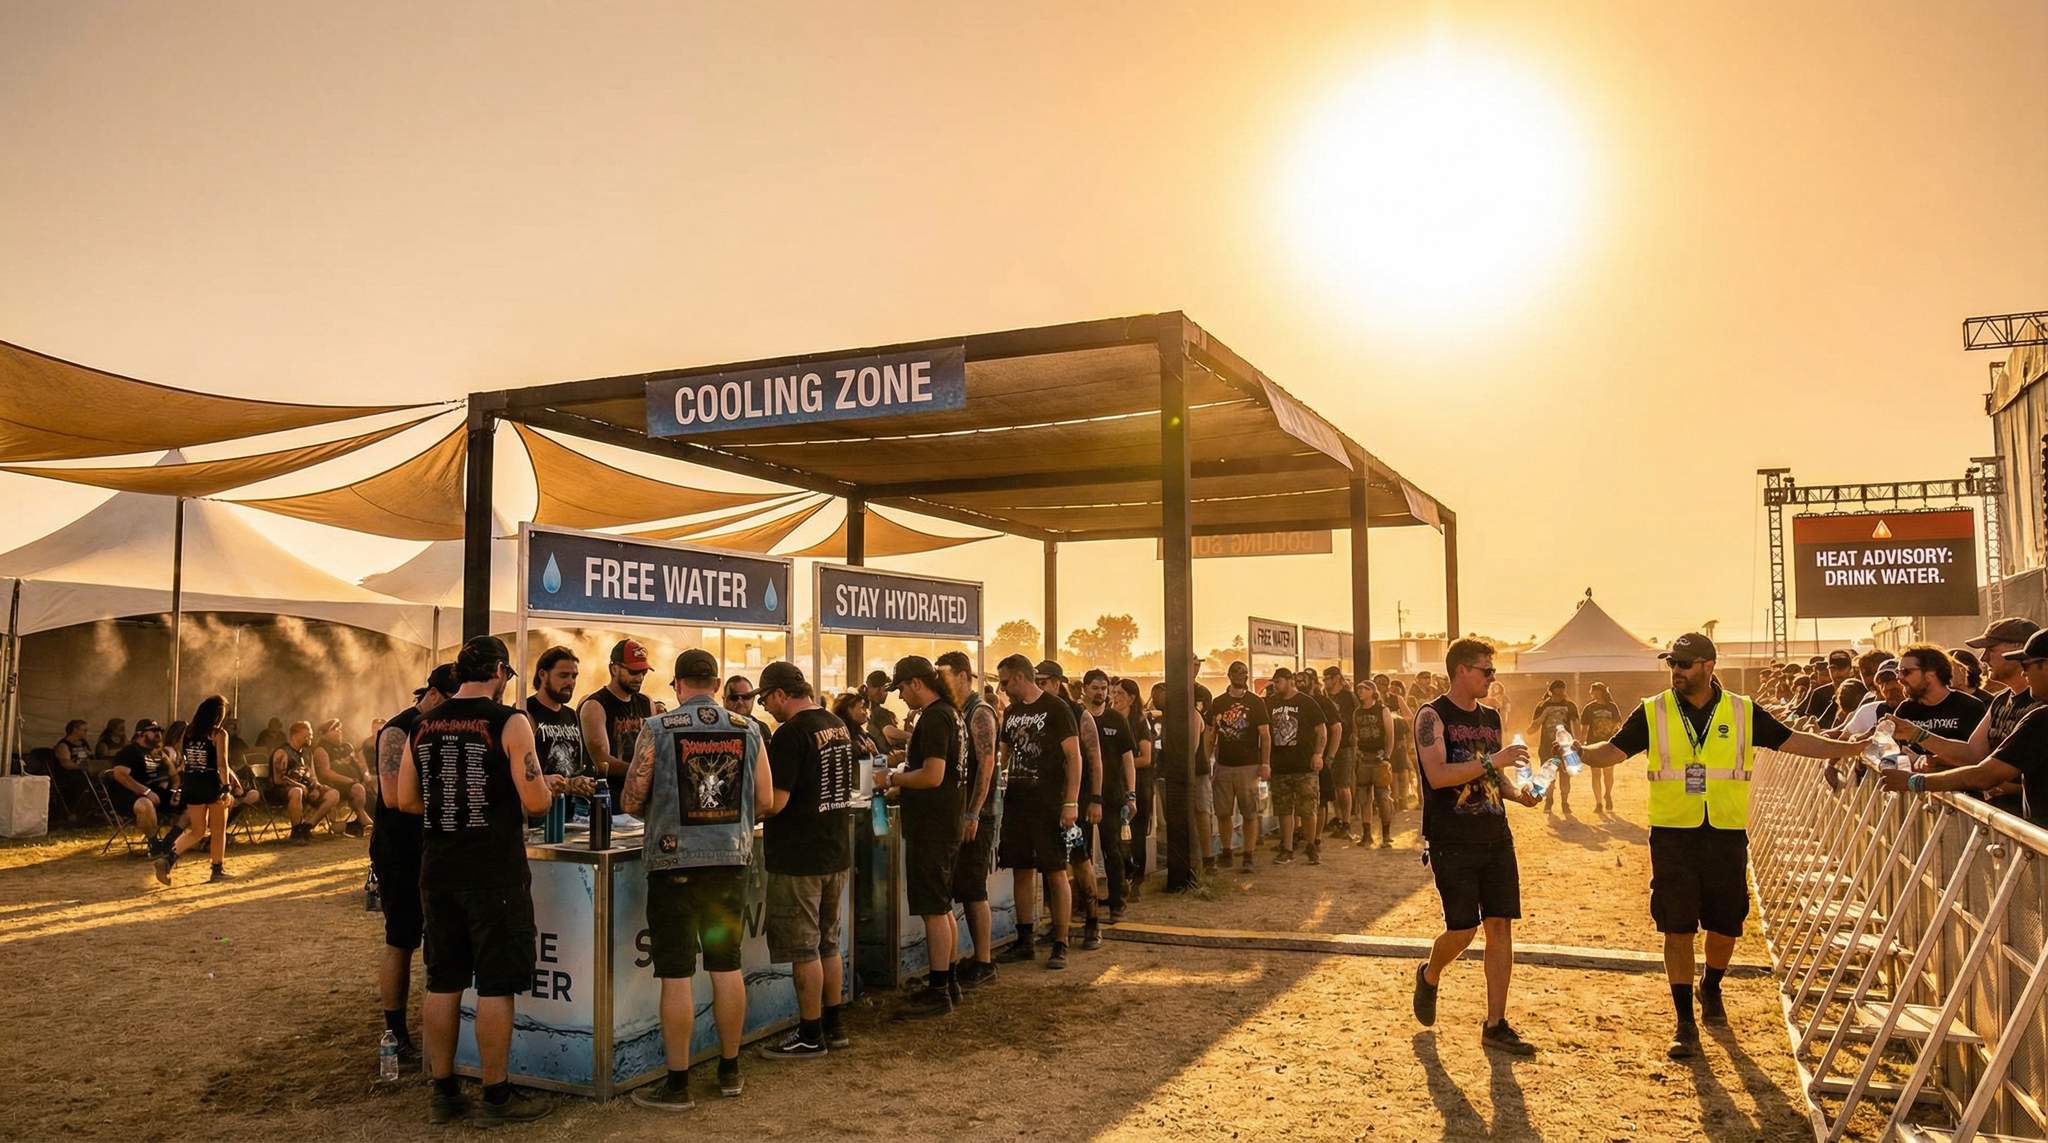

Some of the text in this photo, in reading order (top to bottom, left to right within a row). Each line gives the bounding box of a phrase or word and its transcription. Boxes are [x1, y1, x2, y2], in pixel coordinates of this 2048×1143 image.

[674, 361, 933, 425] COOLING ZONE
[1816, 547, 1953, 567] HEAT ADVISORY:
[1825, 567, 1945, 586] DRINK WATER.
[585, 556, 748, 609] FREE WATER
[835, 583, 967, 624] STAY HYDRATED
